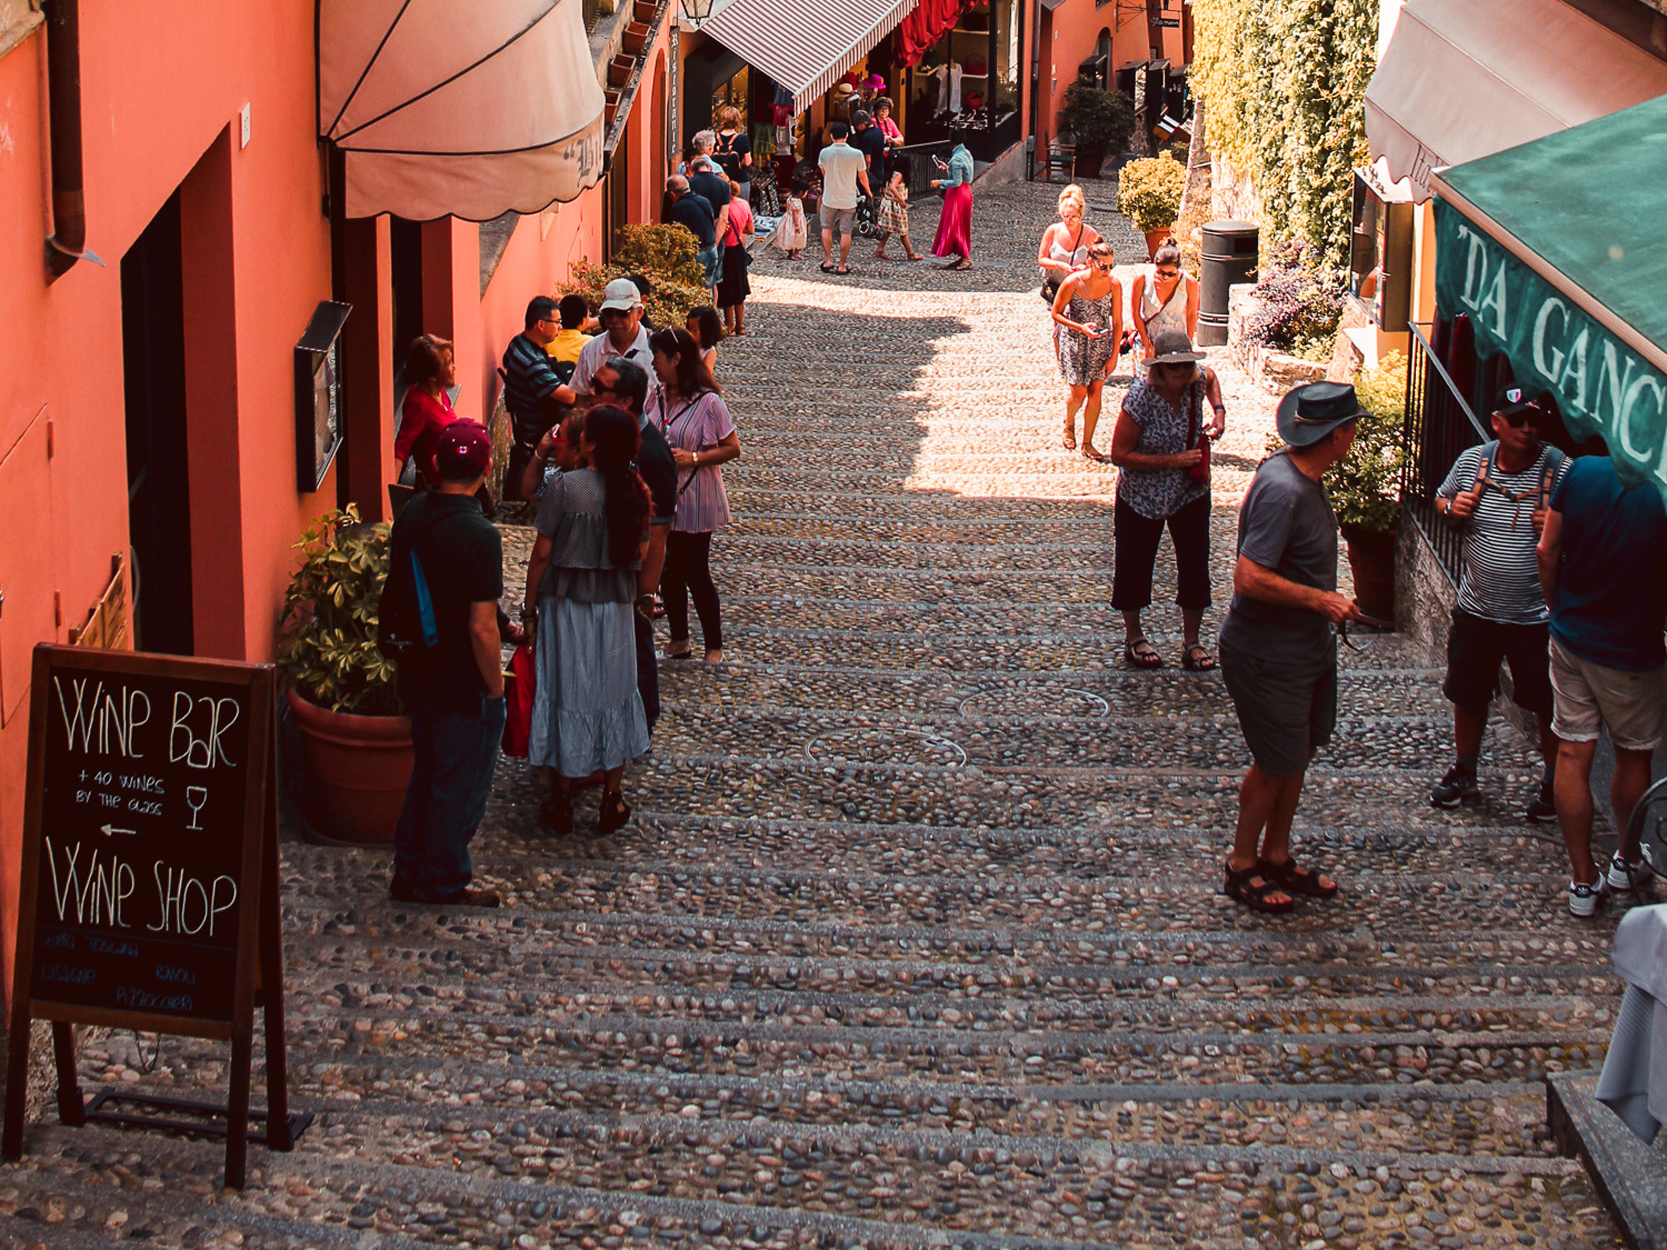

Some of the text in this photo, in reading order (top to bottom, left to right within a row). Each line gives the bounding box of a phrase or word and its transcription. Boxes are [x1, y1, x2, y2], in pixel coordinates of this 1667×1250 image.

[93, 771, 113, 786] 40
[76, 790, 92, 803] BY
[147, 860, 238, 937] SHOP
